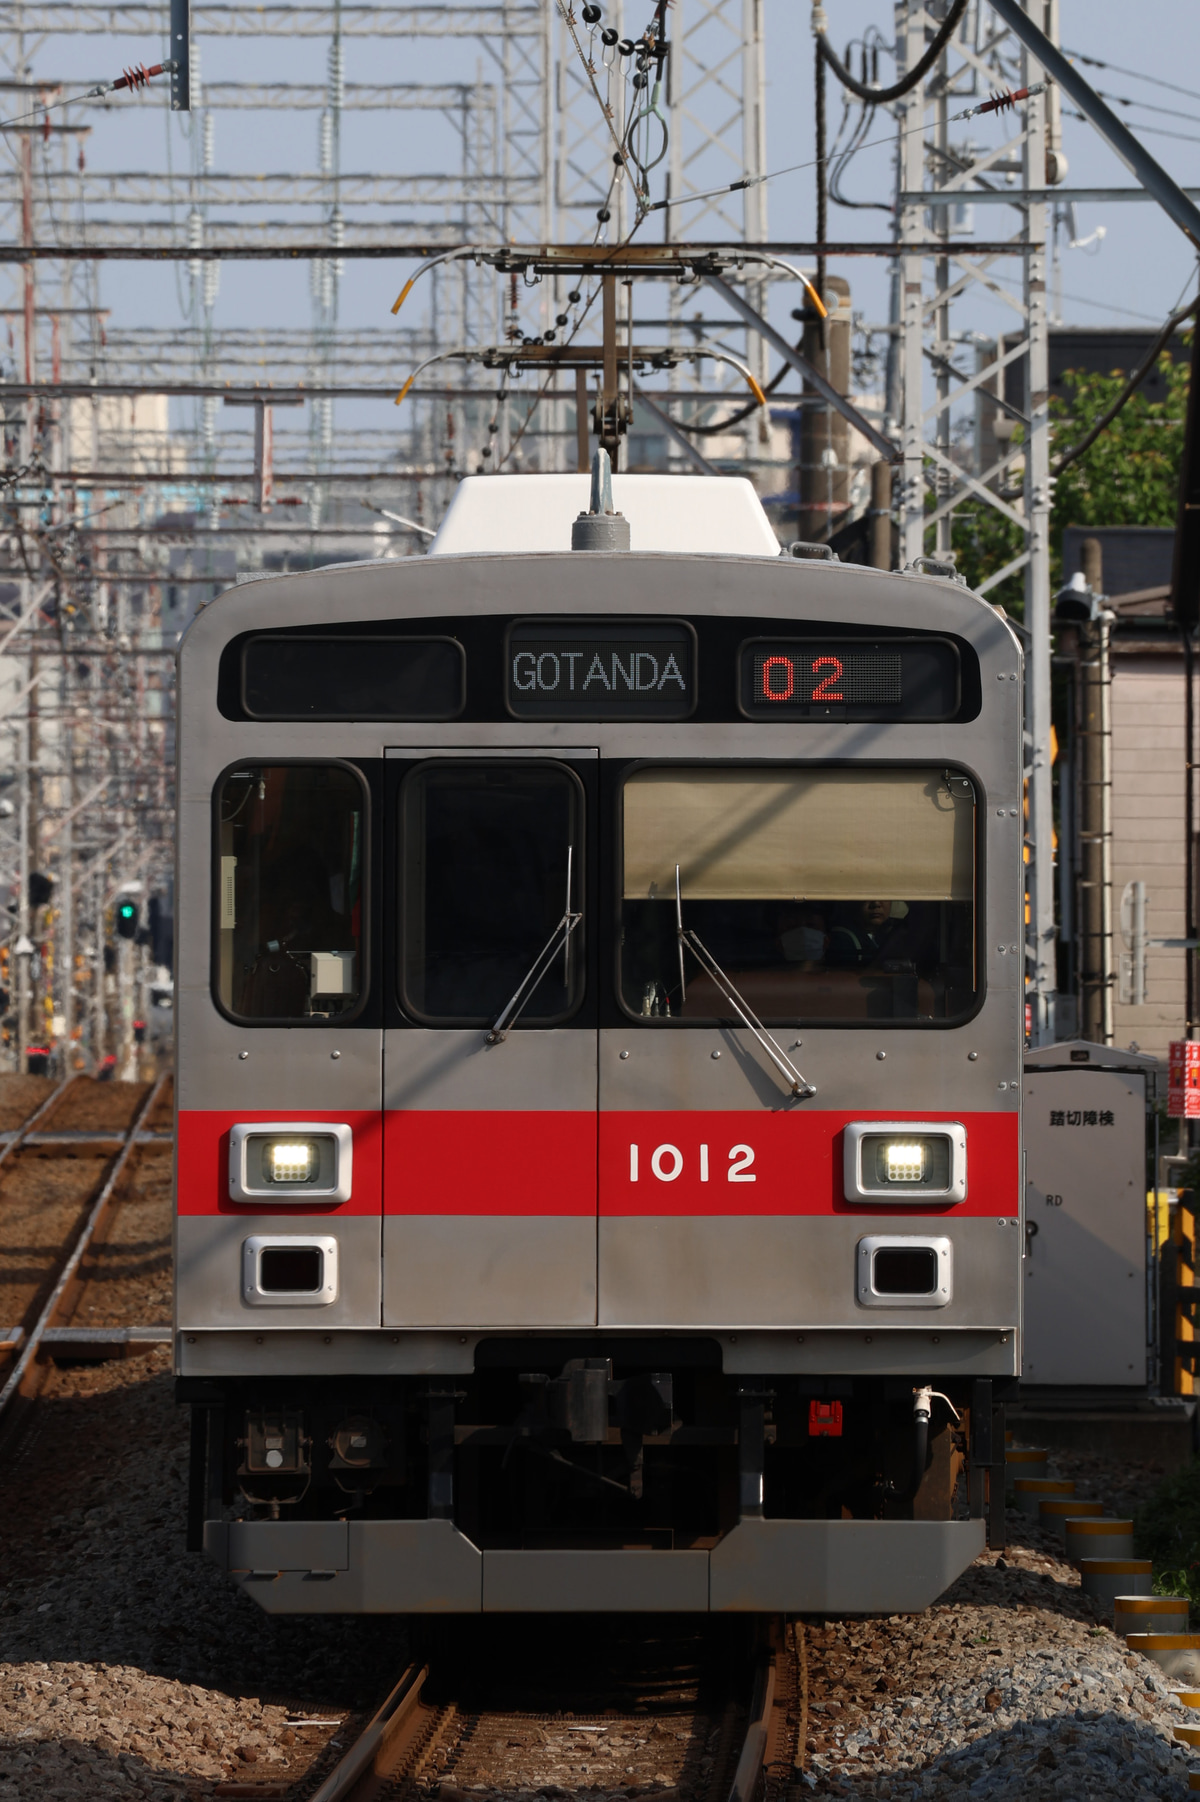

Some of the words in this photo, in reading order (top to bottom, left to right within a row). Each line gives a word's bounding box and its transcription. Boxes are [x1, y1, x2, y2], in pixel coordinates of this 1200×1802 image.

[513, 652, 686, 690] GOTANDA
[1049, 1110, 1115, 1126] 踏切障検
[629, 1143, 757, 1183] 1012
[1045, 1194, 1063, 1207] RD
